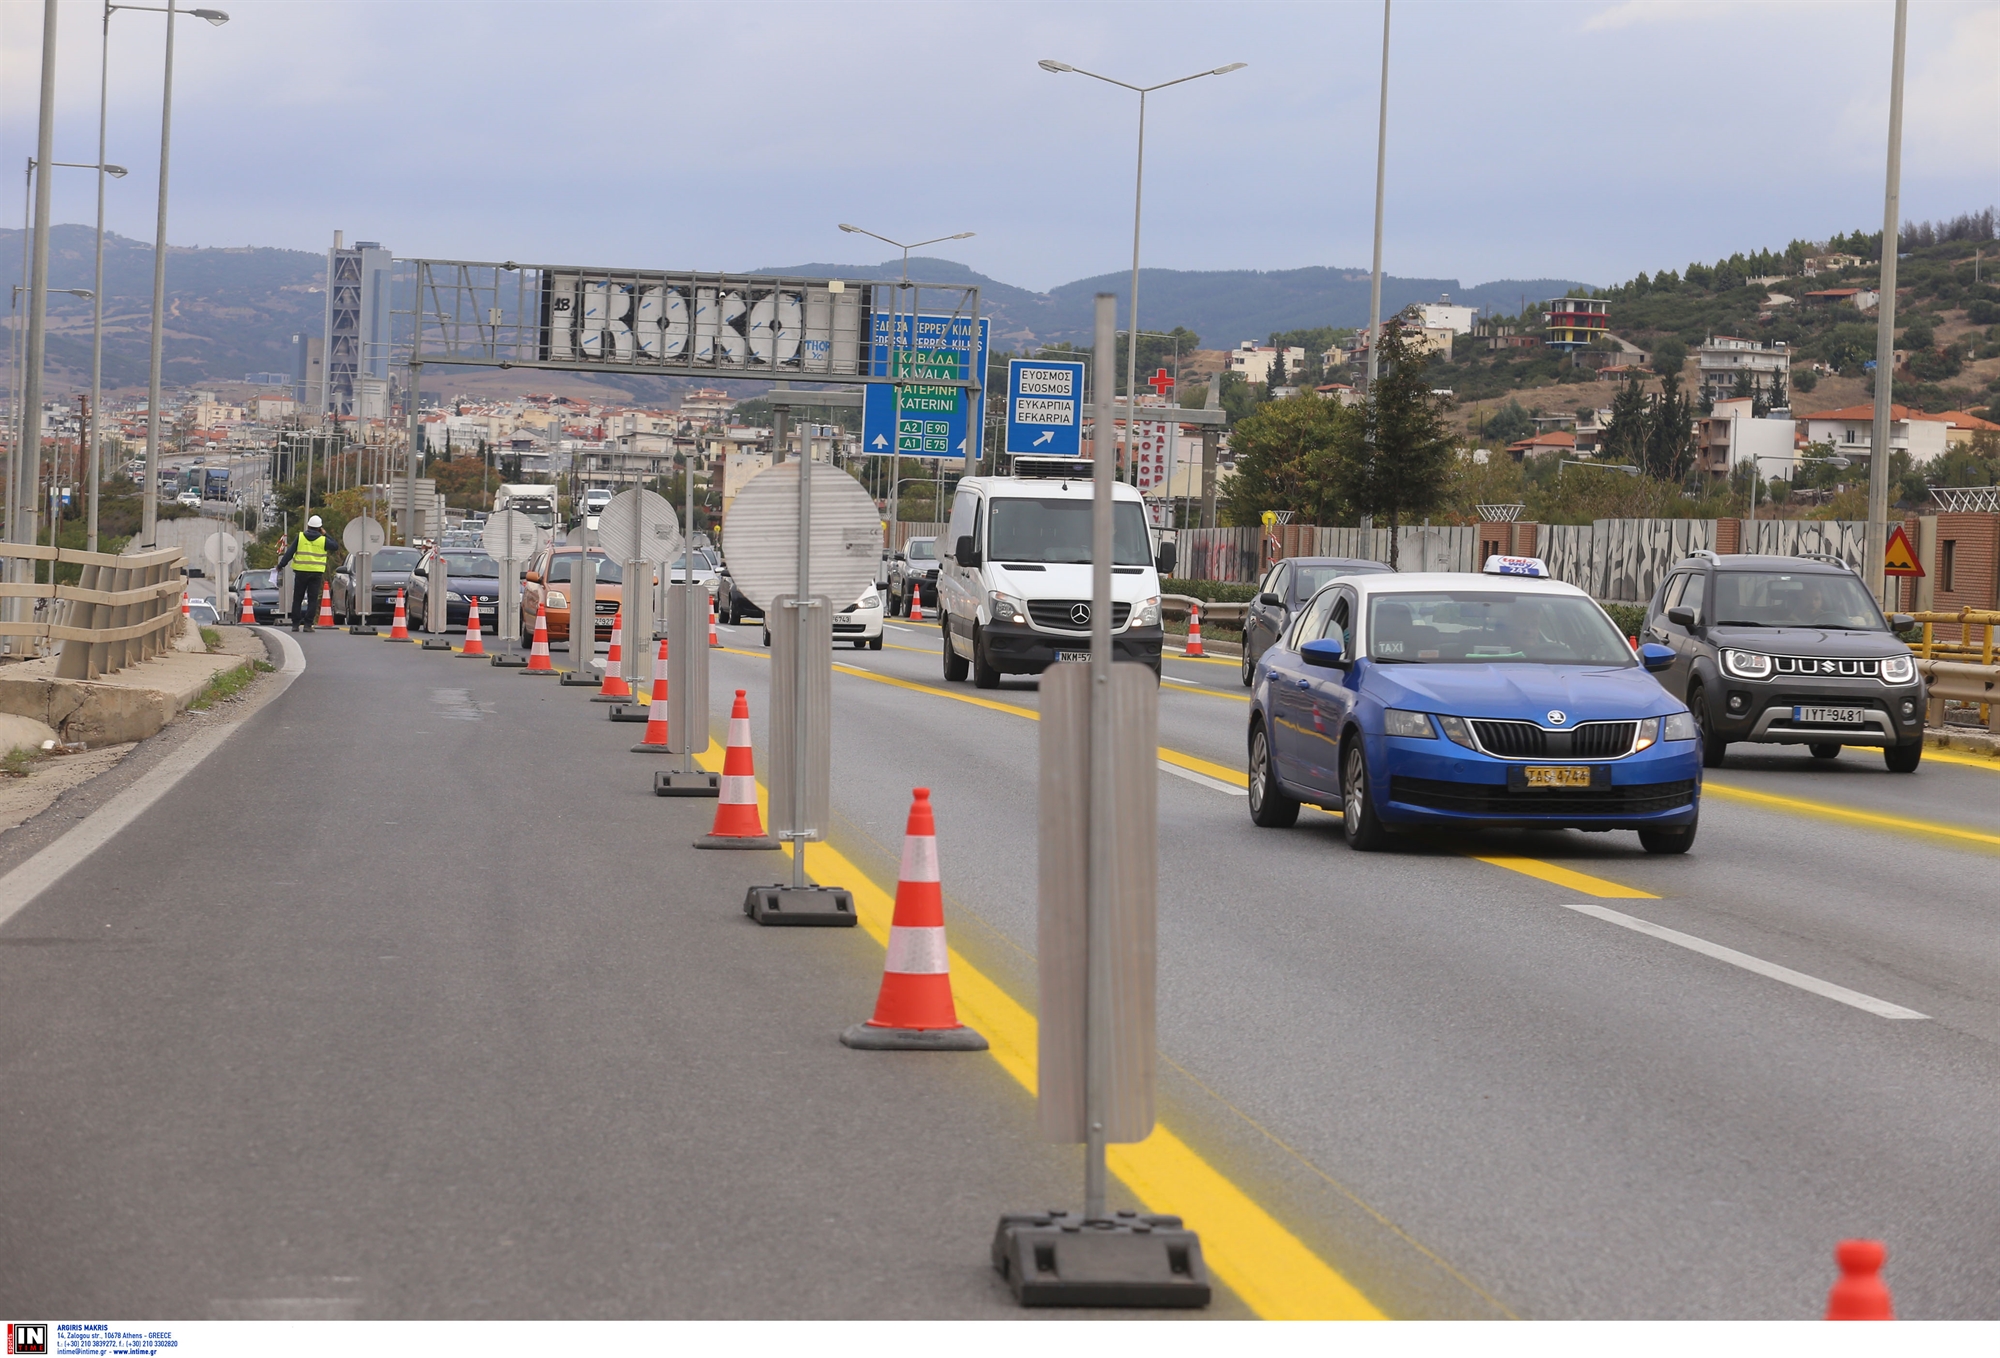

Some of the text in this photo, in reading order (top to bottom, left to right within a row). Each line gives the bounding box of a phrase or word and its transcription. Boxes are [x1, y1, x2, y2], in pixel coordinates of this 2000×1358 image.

[553, 297, 570, 311] 18
[1022, 370, 1071, 382] ΕΥΟΣΜΟΣ
[1021, 383, 1070, 394] EVOSMOS
[1018, 400, 1071, 411] ΕΥΚΑΡΠΙΑ
[1018, 412, 1070, 423] EFKARPIA
[903, 423, 918, 432] A2
[904, 439, 916, 448] A1
[1378, 642, 1404, 653] TAXI
